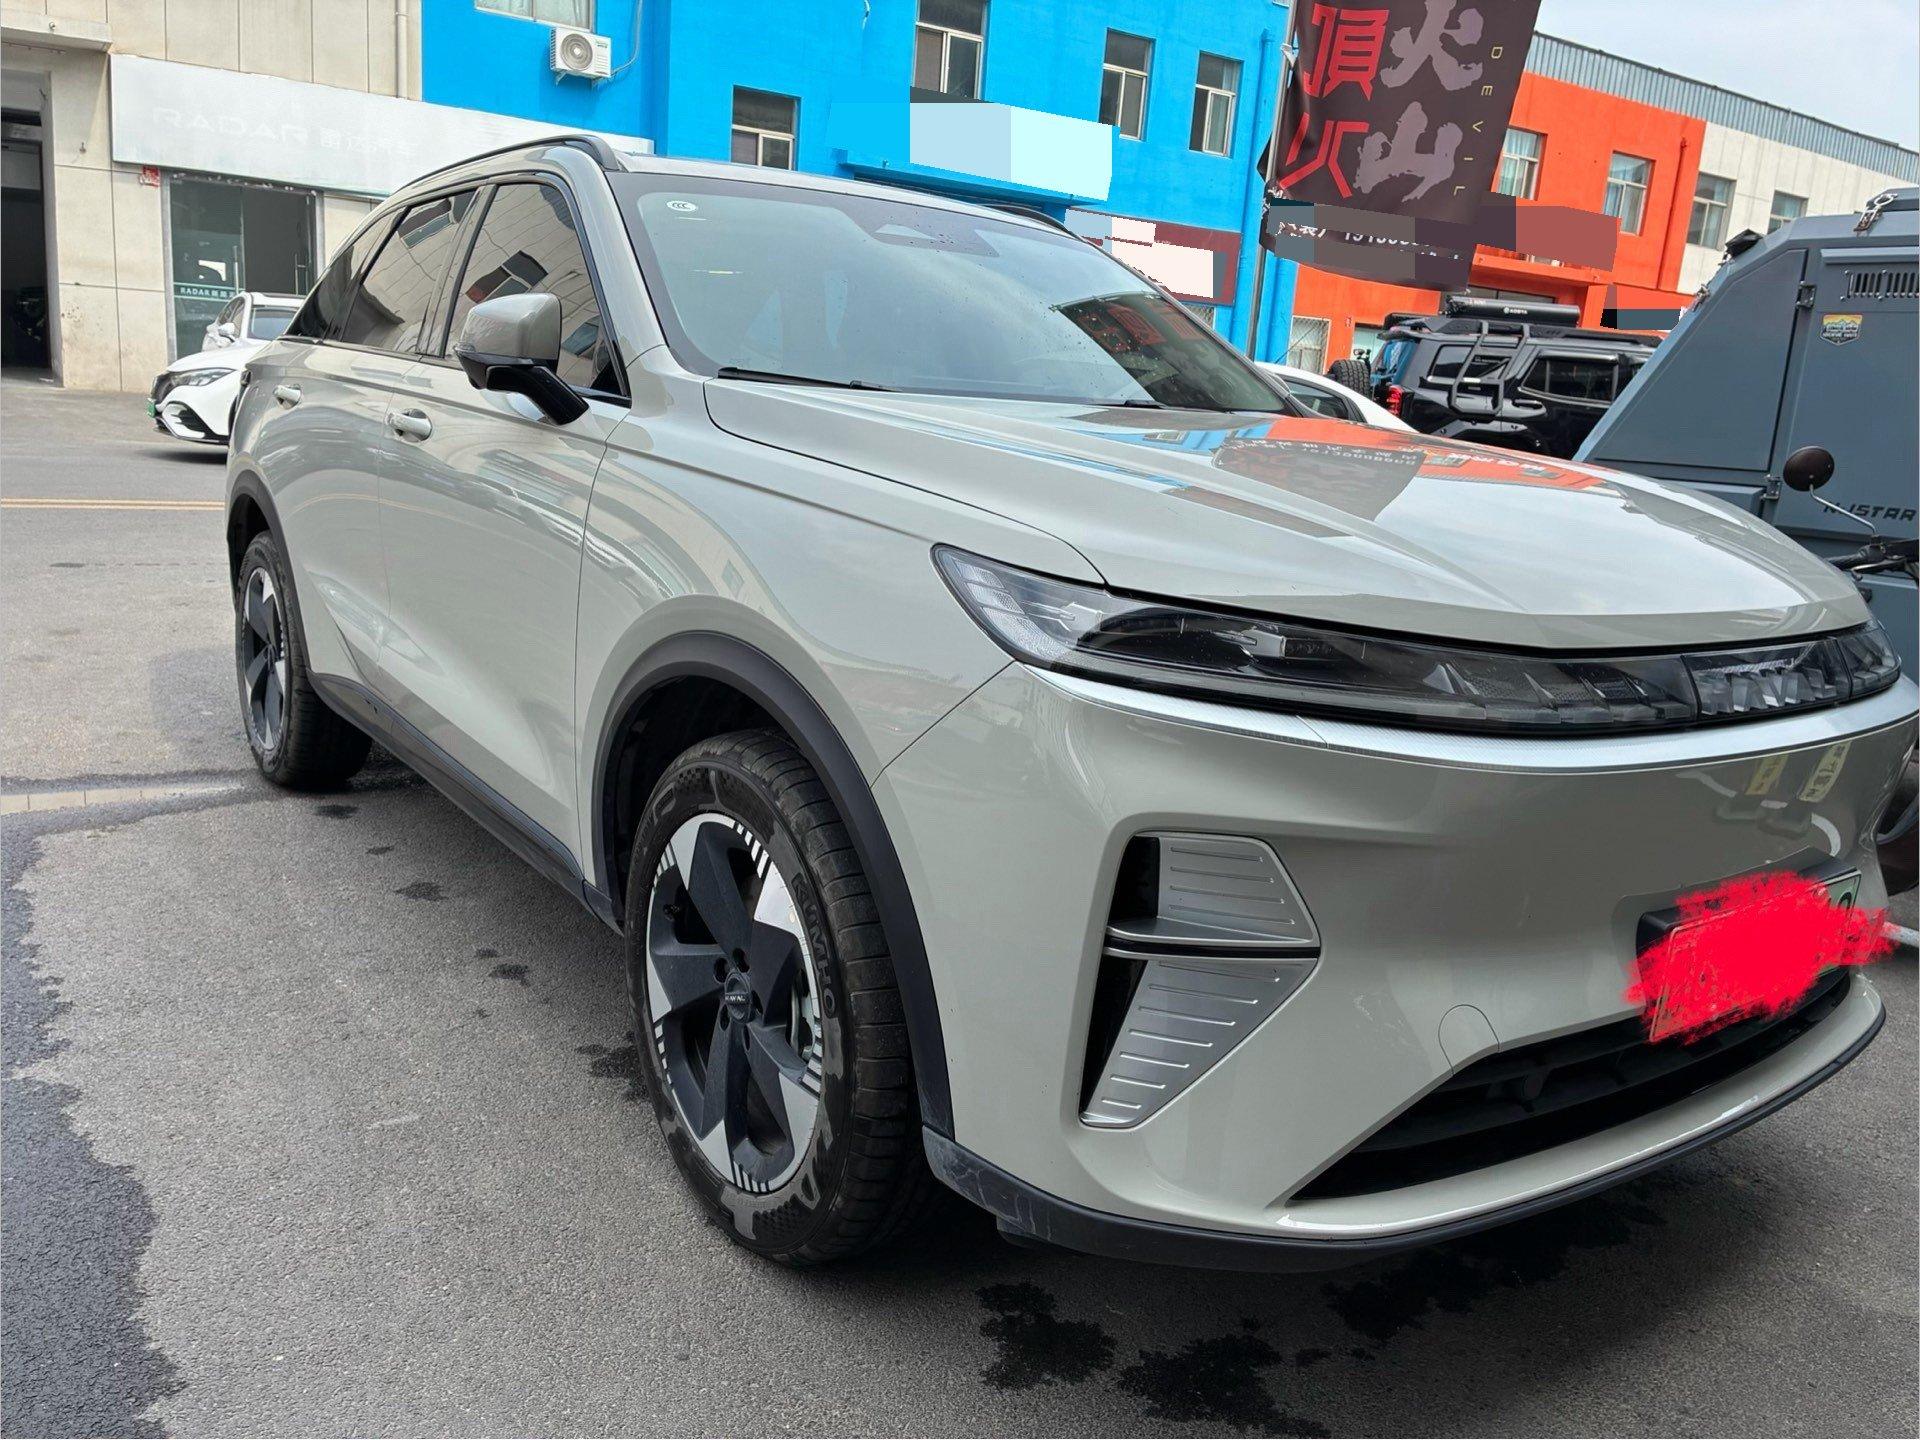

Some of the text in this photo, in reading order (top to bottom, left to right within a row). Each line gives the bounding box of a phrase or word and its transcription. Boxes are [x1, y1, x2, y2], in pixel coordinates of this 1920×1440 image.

[152, 107, 309, 146] RADAR
[1452, 46, 1503, 196] DEVIL
[180, 287, 210, 296] RADAR
